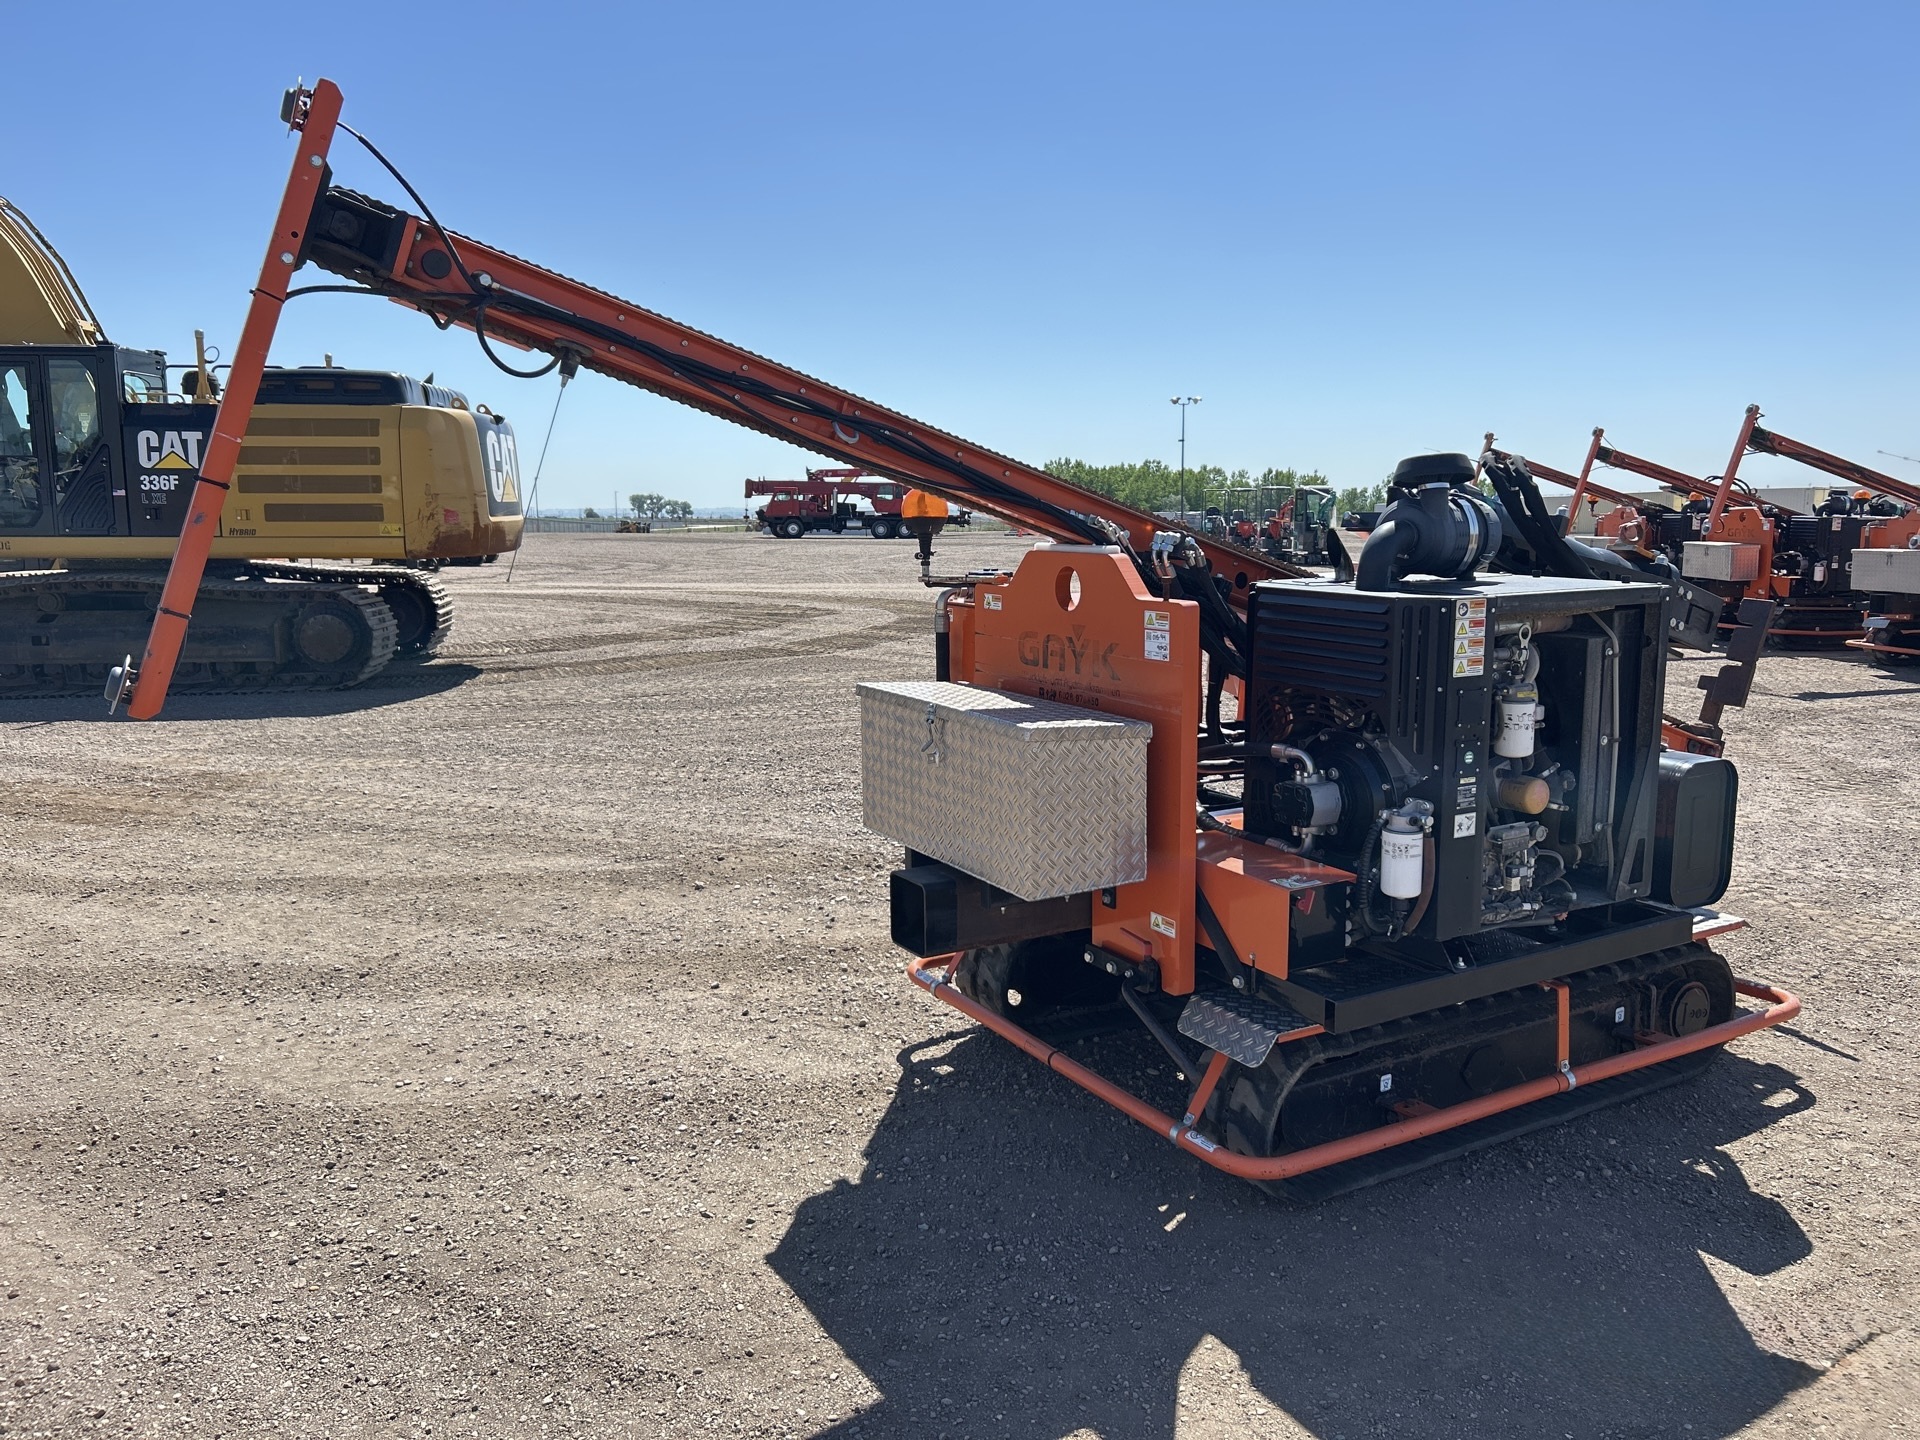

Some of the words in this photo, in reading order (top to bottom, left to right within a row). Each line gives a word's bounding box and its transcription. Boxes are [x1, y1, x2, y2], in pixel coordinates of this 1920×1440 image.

[137, 430, 203, 469] CAT
[486, 430, 519, 502] CAT
[140, 475, 179, 490] 336F
[141, 493, 149, 504] L
[152, 493, 167, 504] XE
[229, 528, 257, 536] HYBRID
[1018, 628, 1121, 681] GAYK
